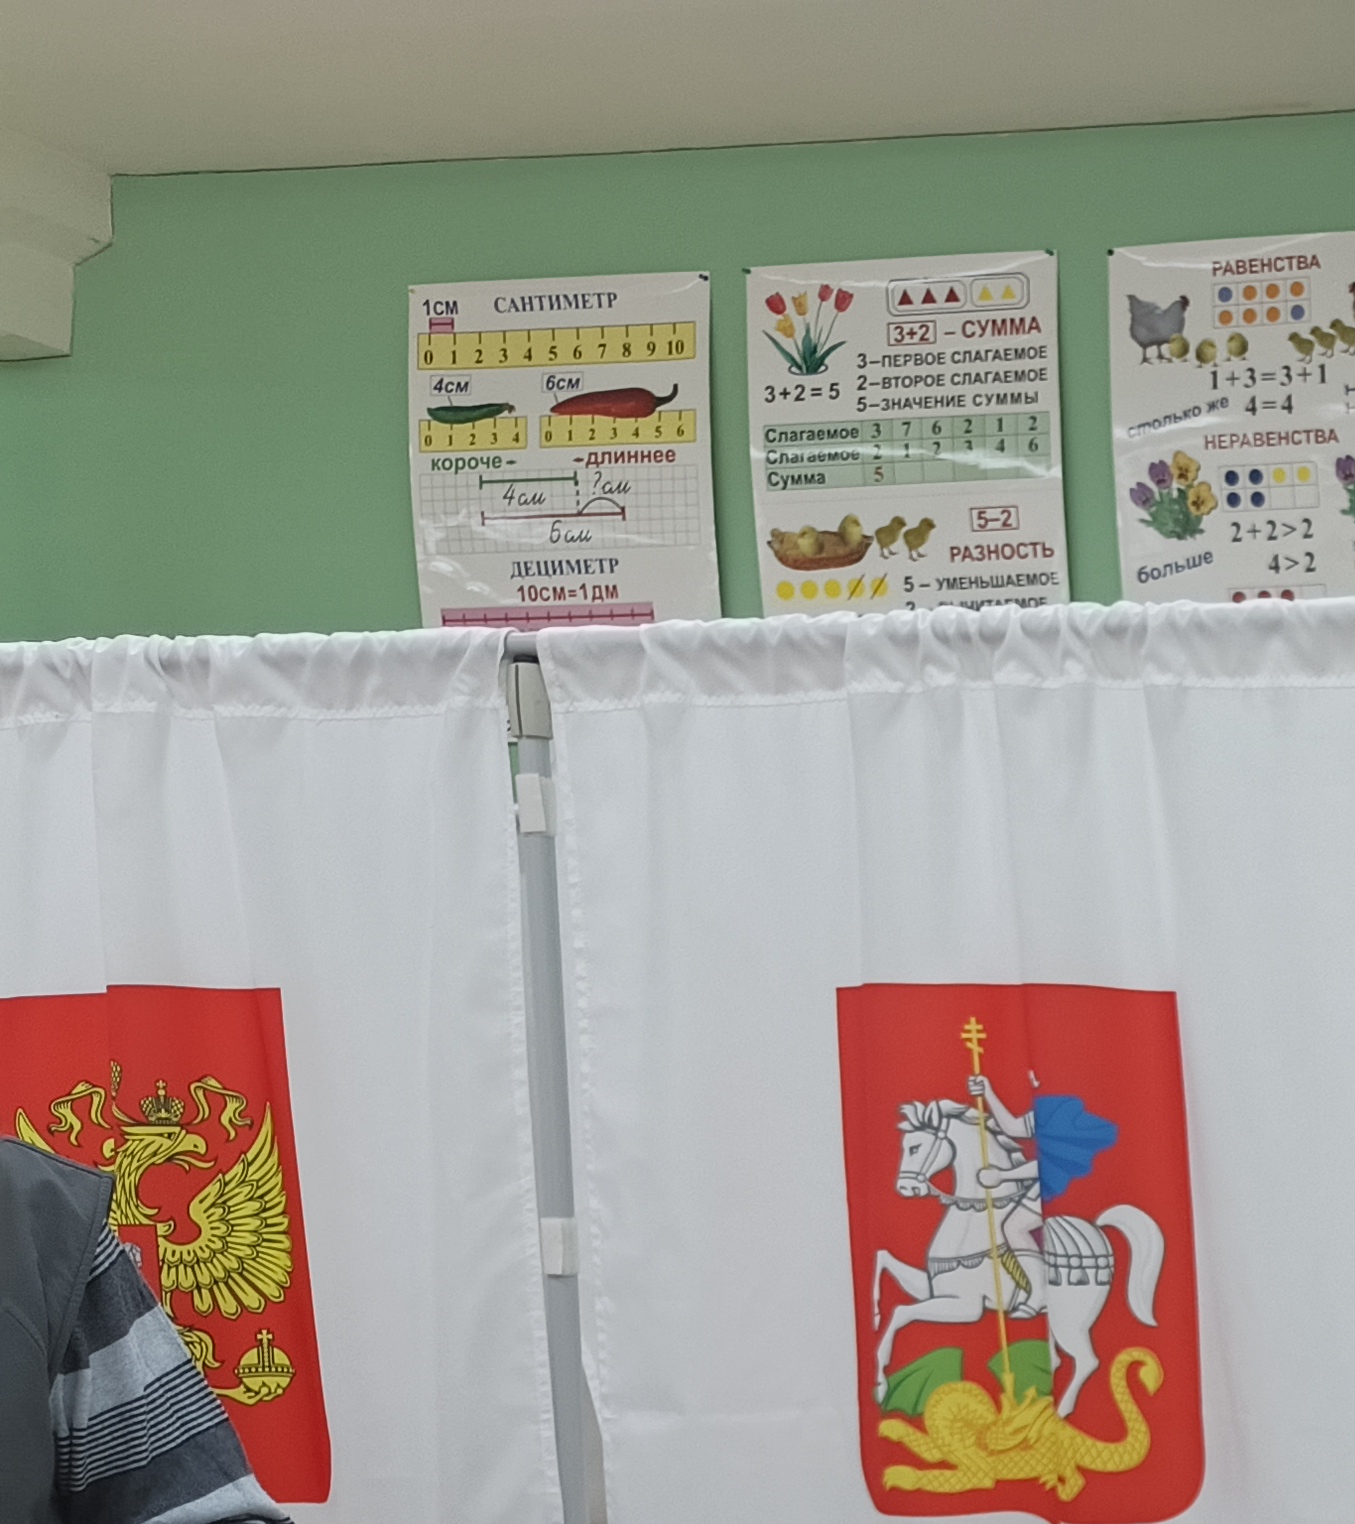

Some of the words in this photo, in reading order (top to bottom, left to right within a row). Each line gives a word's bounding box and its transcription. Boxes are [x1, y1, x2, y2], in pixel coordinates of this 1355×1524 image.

[1212, 254, 1321, 277] РАВЕНСТВА
[422, 299, 458, 316] 1СМ
[493, 292, 617, 313] САНТИМЕТР
[961, 316, 1042, 338] СУММА
[423, 349, 433, 365] 0
[450, 349, 457, 365] 1
[474, 348, 483, 364] 2
[498, 347, 508, 363] 3
[523, 346, 532, 362] 4
[548, 345, 558, 361] 5
[573, 344, 582, 360] 6
[598, 343, 607, 359] 7
[622, 342, 632, 358] 8
[646, 341, 656, 357] 9
[667, 340, 684, 356] 10
[951, 345, 1048, 364] СЛАГАЕМОЕ
[433, 378, 469, 393] 4см
[545, 374, 580, 391] 6см
[951, 367, 1048, 386] СЛАГАЕМОЕ
[972, 391, 1039, 407] СУММЫ
[1206, 397, 1229, 412] же
[424, 434, 432, 447] 0
[447, 434, 453, 446] 1
[468, 433, 476, 446] 2
[490, 432, 498, 445] 3
[512, 431, 520, 444] 4
[545, 430, 552, 443] 0
[567, 429, 573, 442] 1
[588, 428, 596, 441] 2
[610, 427, 617, 440] 3
[631, 426, 639, 439] 4
[654, 426, 662, 438] 5
[677, 425, 684, 438] 6
[764, 428, 859, 444] Слагаемое
[871, 423, 882, 439] 3
[902, 421, 911, 437] 7
[932, 420, 942, 435] 6
[964, 418, 973, 433] 2
[996, 417, 1003, 433] 1
[1028, 416, 1037, 431] 2
[1204, 429, 1340, 450] НЕРАВЕНСТВА
[585, 449, 676, 469] длиннее
[766, 449, 860, 465] Слагаемое
[873, 444, 882, 460] 2
[903, 442, 910, 458] 1
[933, 441, 942, 456] 2
[995, 438, 1005, 452] 4
[1028, 437, 1038, 452] 6
[431, 454, 502, 475] короче
[767, 471, 826, 490] Сумма
[873, 466, 884, 483] 5
[950, 542, 1054, 563] РАЗНОСТЬ
[510, 558, 620, 579] ДЕЦИМЕТР
[1137, 551, 1213, 584] больше
[903, 576, 914, 592] 5
[935, 572, 1059, 590] УМЕНЬШАЕМОЕ
